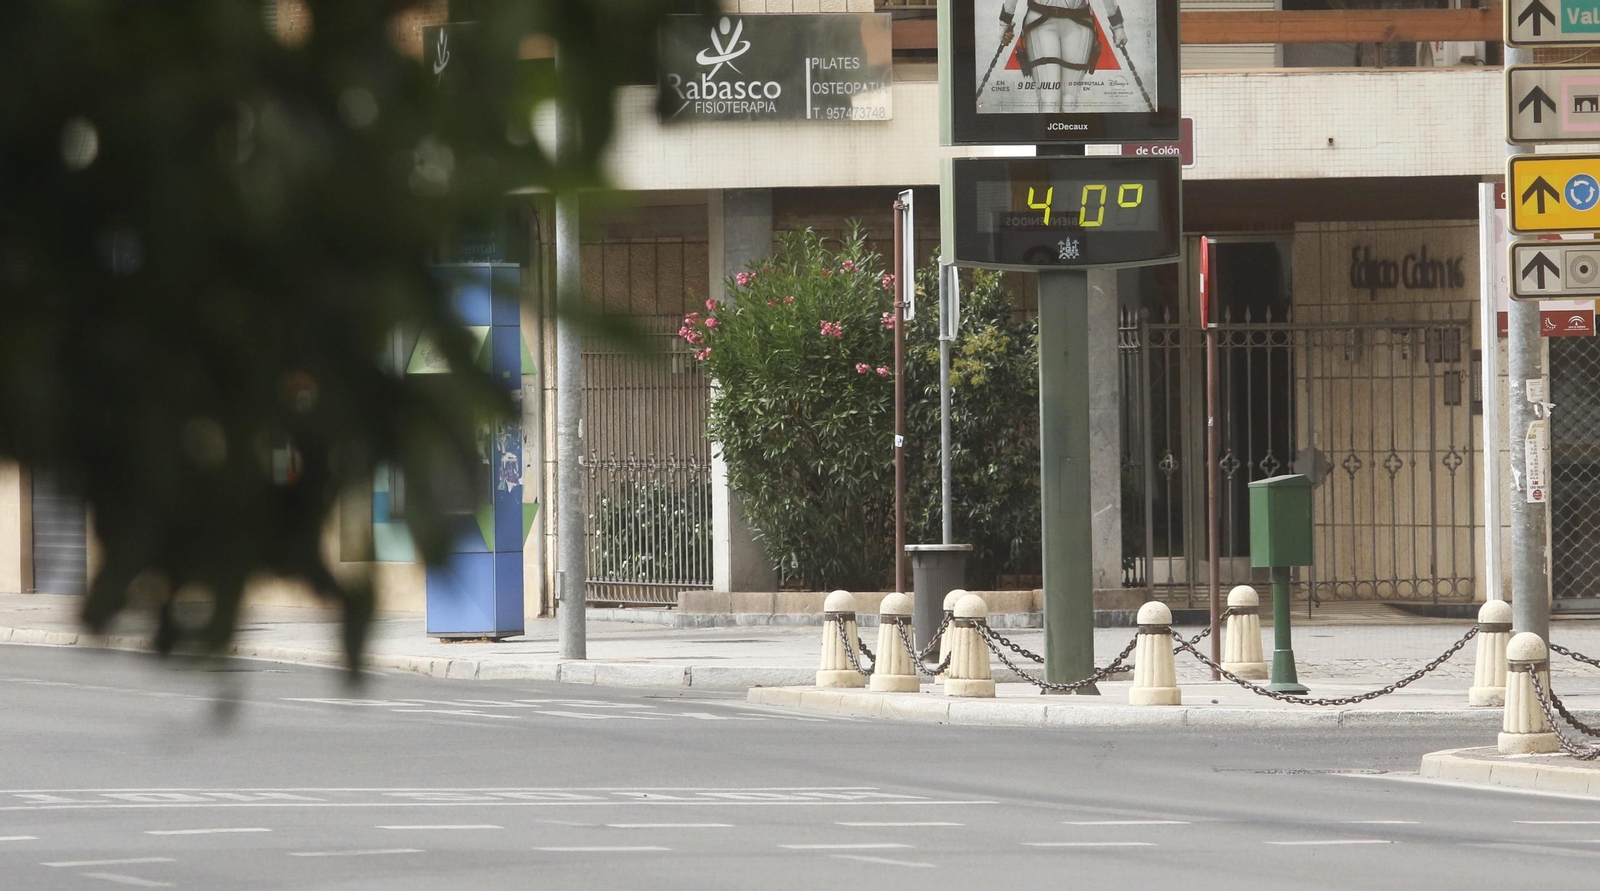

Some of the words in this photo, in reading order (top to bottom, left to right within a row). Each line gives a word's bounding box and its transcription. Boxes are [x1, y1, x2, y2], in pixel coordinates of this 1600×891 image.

[1566, 7, 1600, 25] Val
[811, 57, 860, 70] PILATES
[666, 73, 782, 100] Rabasco
[812, 82, 888, 95] OSTEOPATIA
[1017, 81, 1024, 90] 9
[1024, 81, 1037, 90] DE
[1037, 81, 1061, 90] JULIO
[695, 101, 777, 114] FISIOTERAPIA
[812, 107, 824, 120] T.
[826, 107, 886, 120] 957473748
[1047, 122, 1089, 131] JCDecaux
[1135, 146, 1149, 156] de
[1151, 145, 1180, 156] Colón
